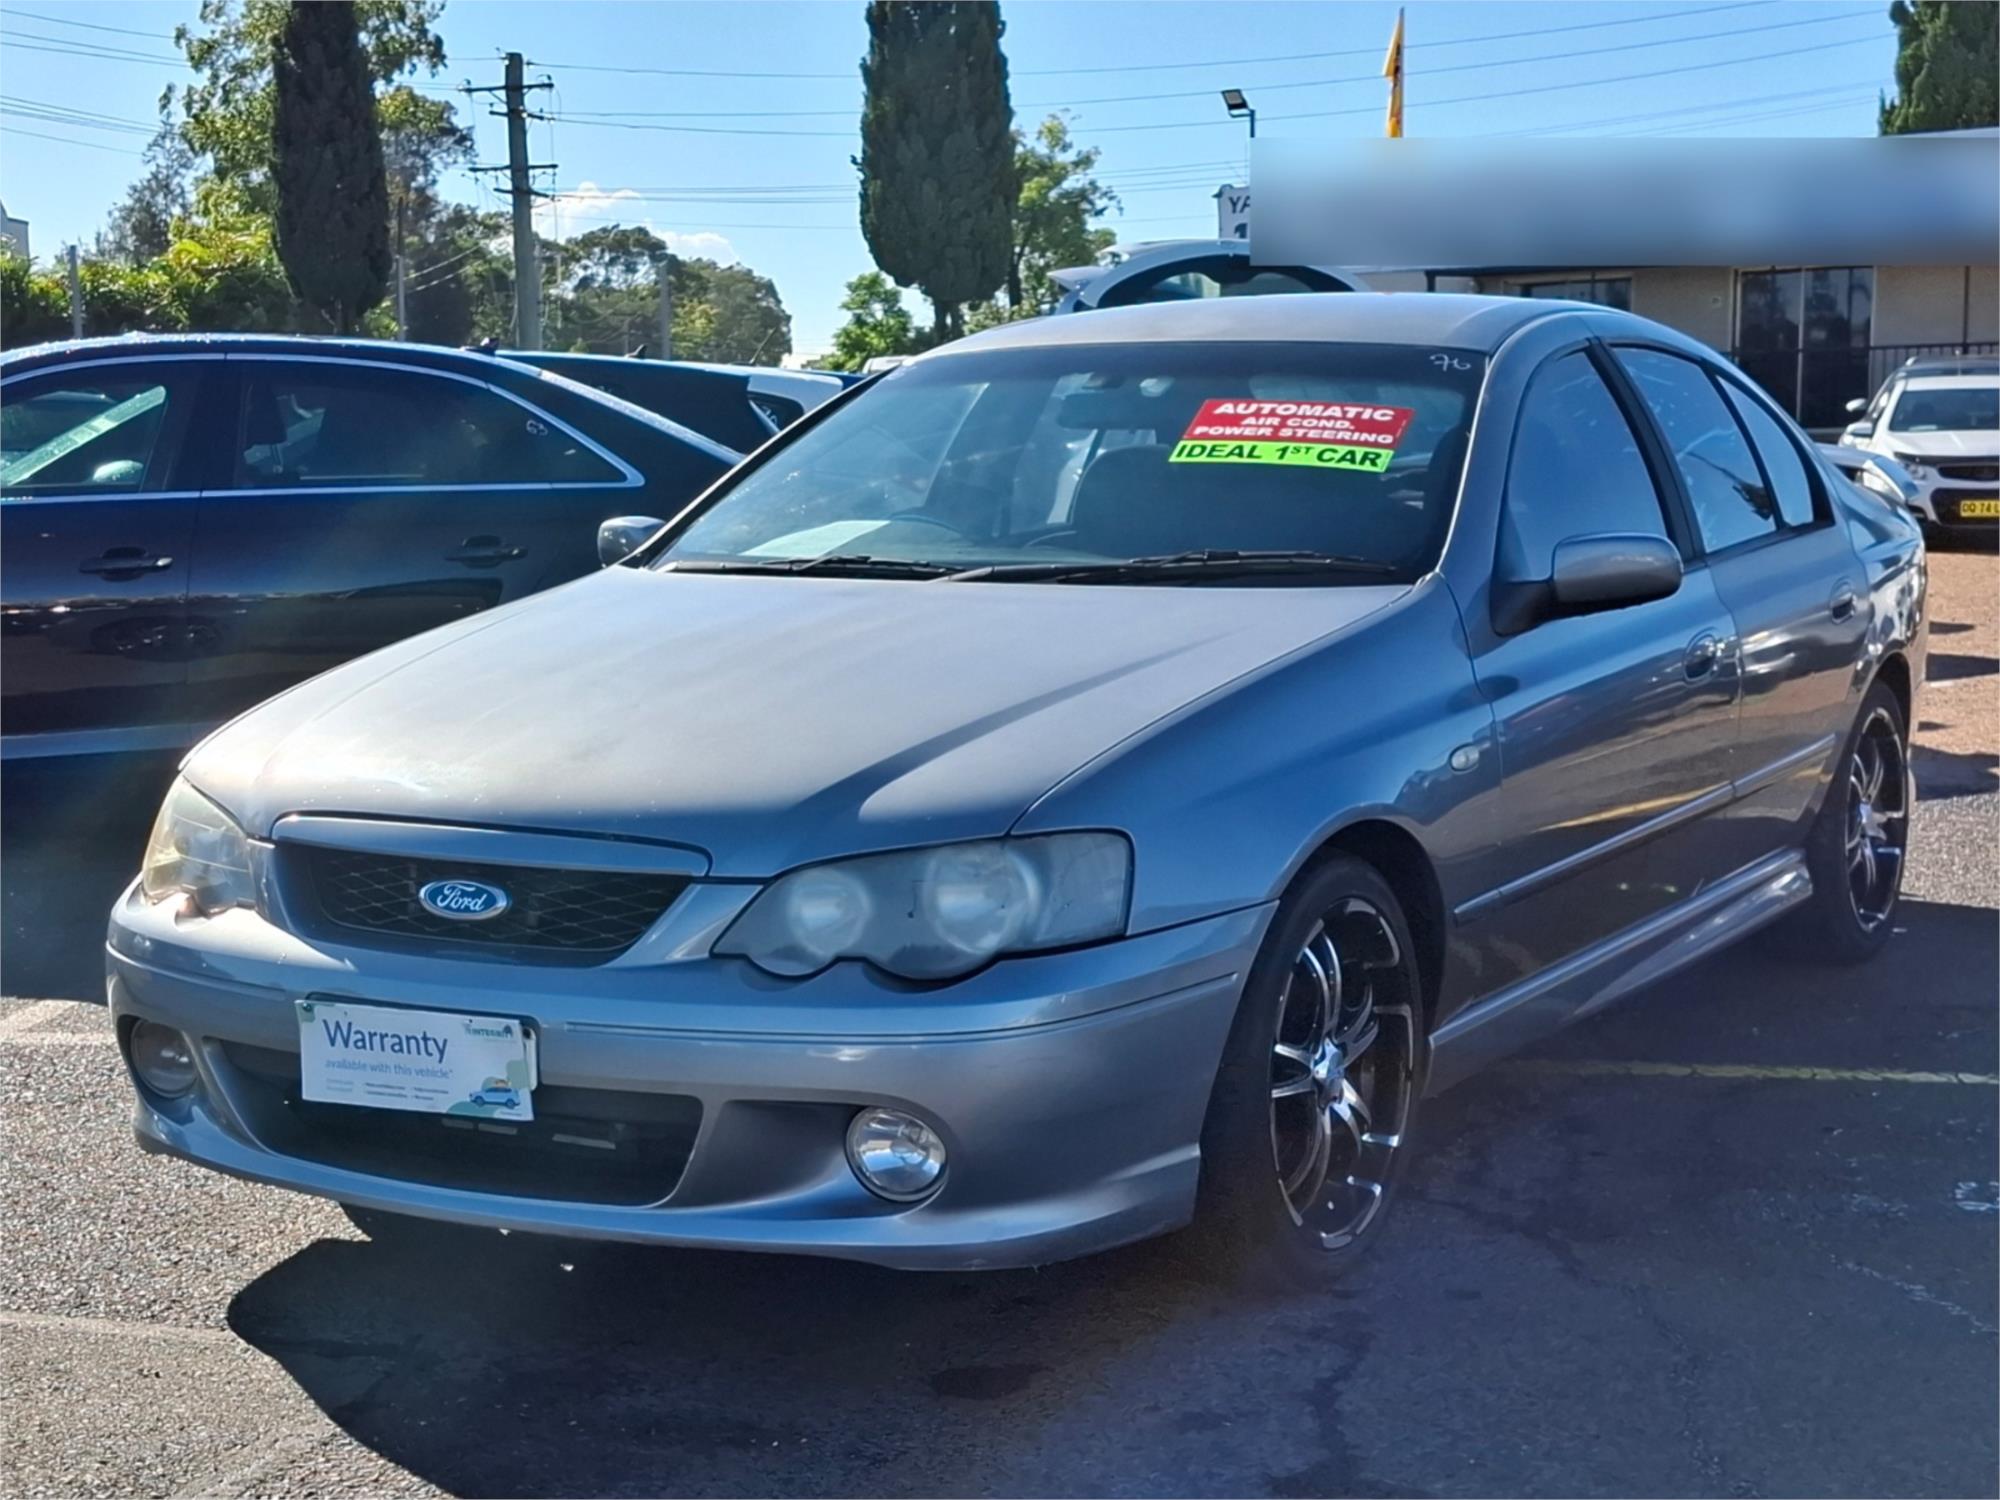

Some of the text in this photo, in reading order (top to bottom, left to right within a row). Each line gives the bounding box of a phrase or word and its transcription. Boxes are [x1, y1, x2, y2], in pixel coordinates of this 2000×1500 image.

[1213, 403, 1395, 421] AUTOMATIC
[1241, 416, 1355, 430] AIR COND.
[1193, 426, 1274, 436] POWER
[1278, 427, 1394, 444] STEERING
[1176, 444, 1382, 467] IDEAL 1ST CAR
[437, 884, 487, 911] Ford
[322, 1019, 448, 1064] Warranty
[326, 1060, 367, 1072] available
[370, 1064, 392, 1073] with
[394, 1064, 412, 1075] this
